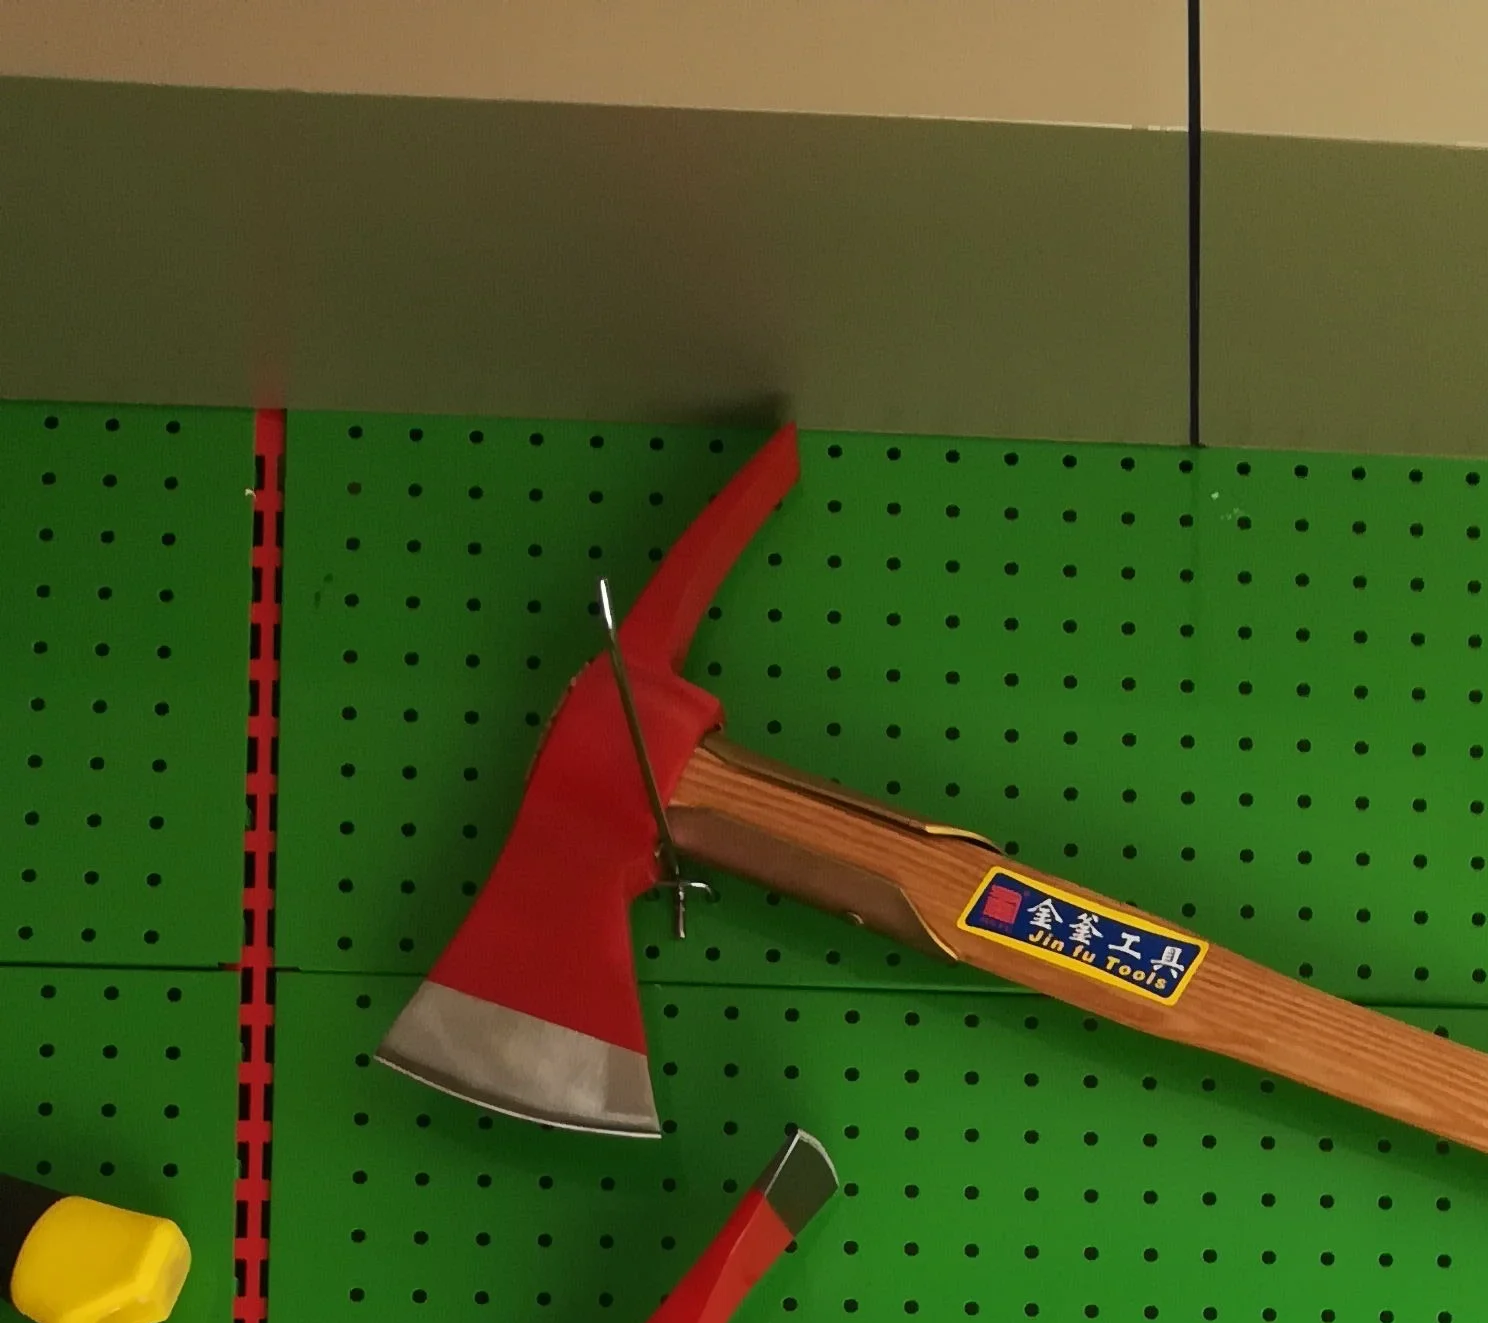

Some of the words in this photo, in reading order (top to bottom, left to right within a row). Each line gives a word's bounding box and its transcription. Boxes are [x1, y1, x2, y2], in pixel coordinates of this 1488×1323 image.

[1027, 898, 1185, 979] 金釜工具
[1028, 930, 1065, 951] Jin
[1105, 955, 1167, 990] Tools
